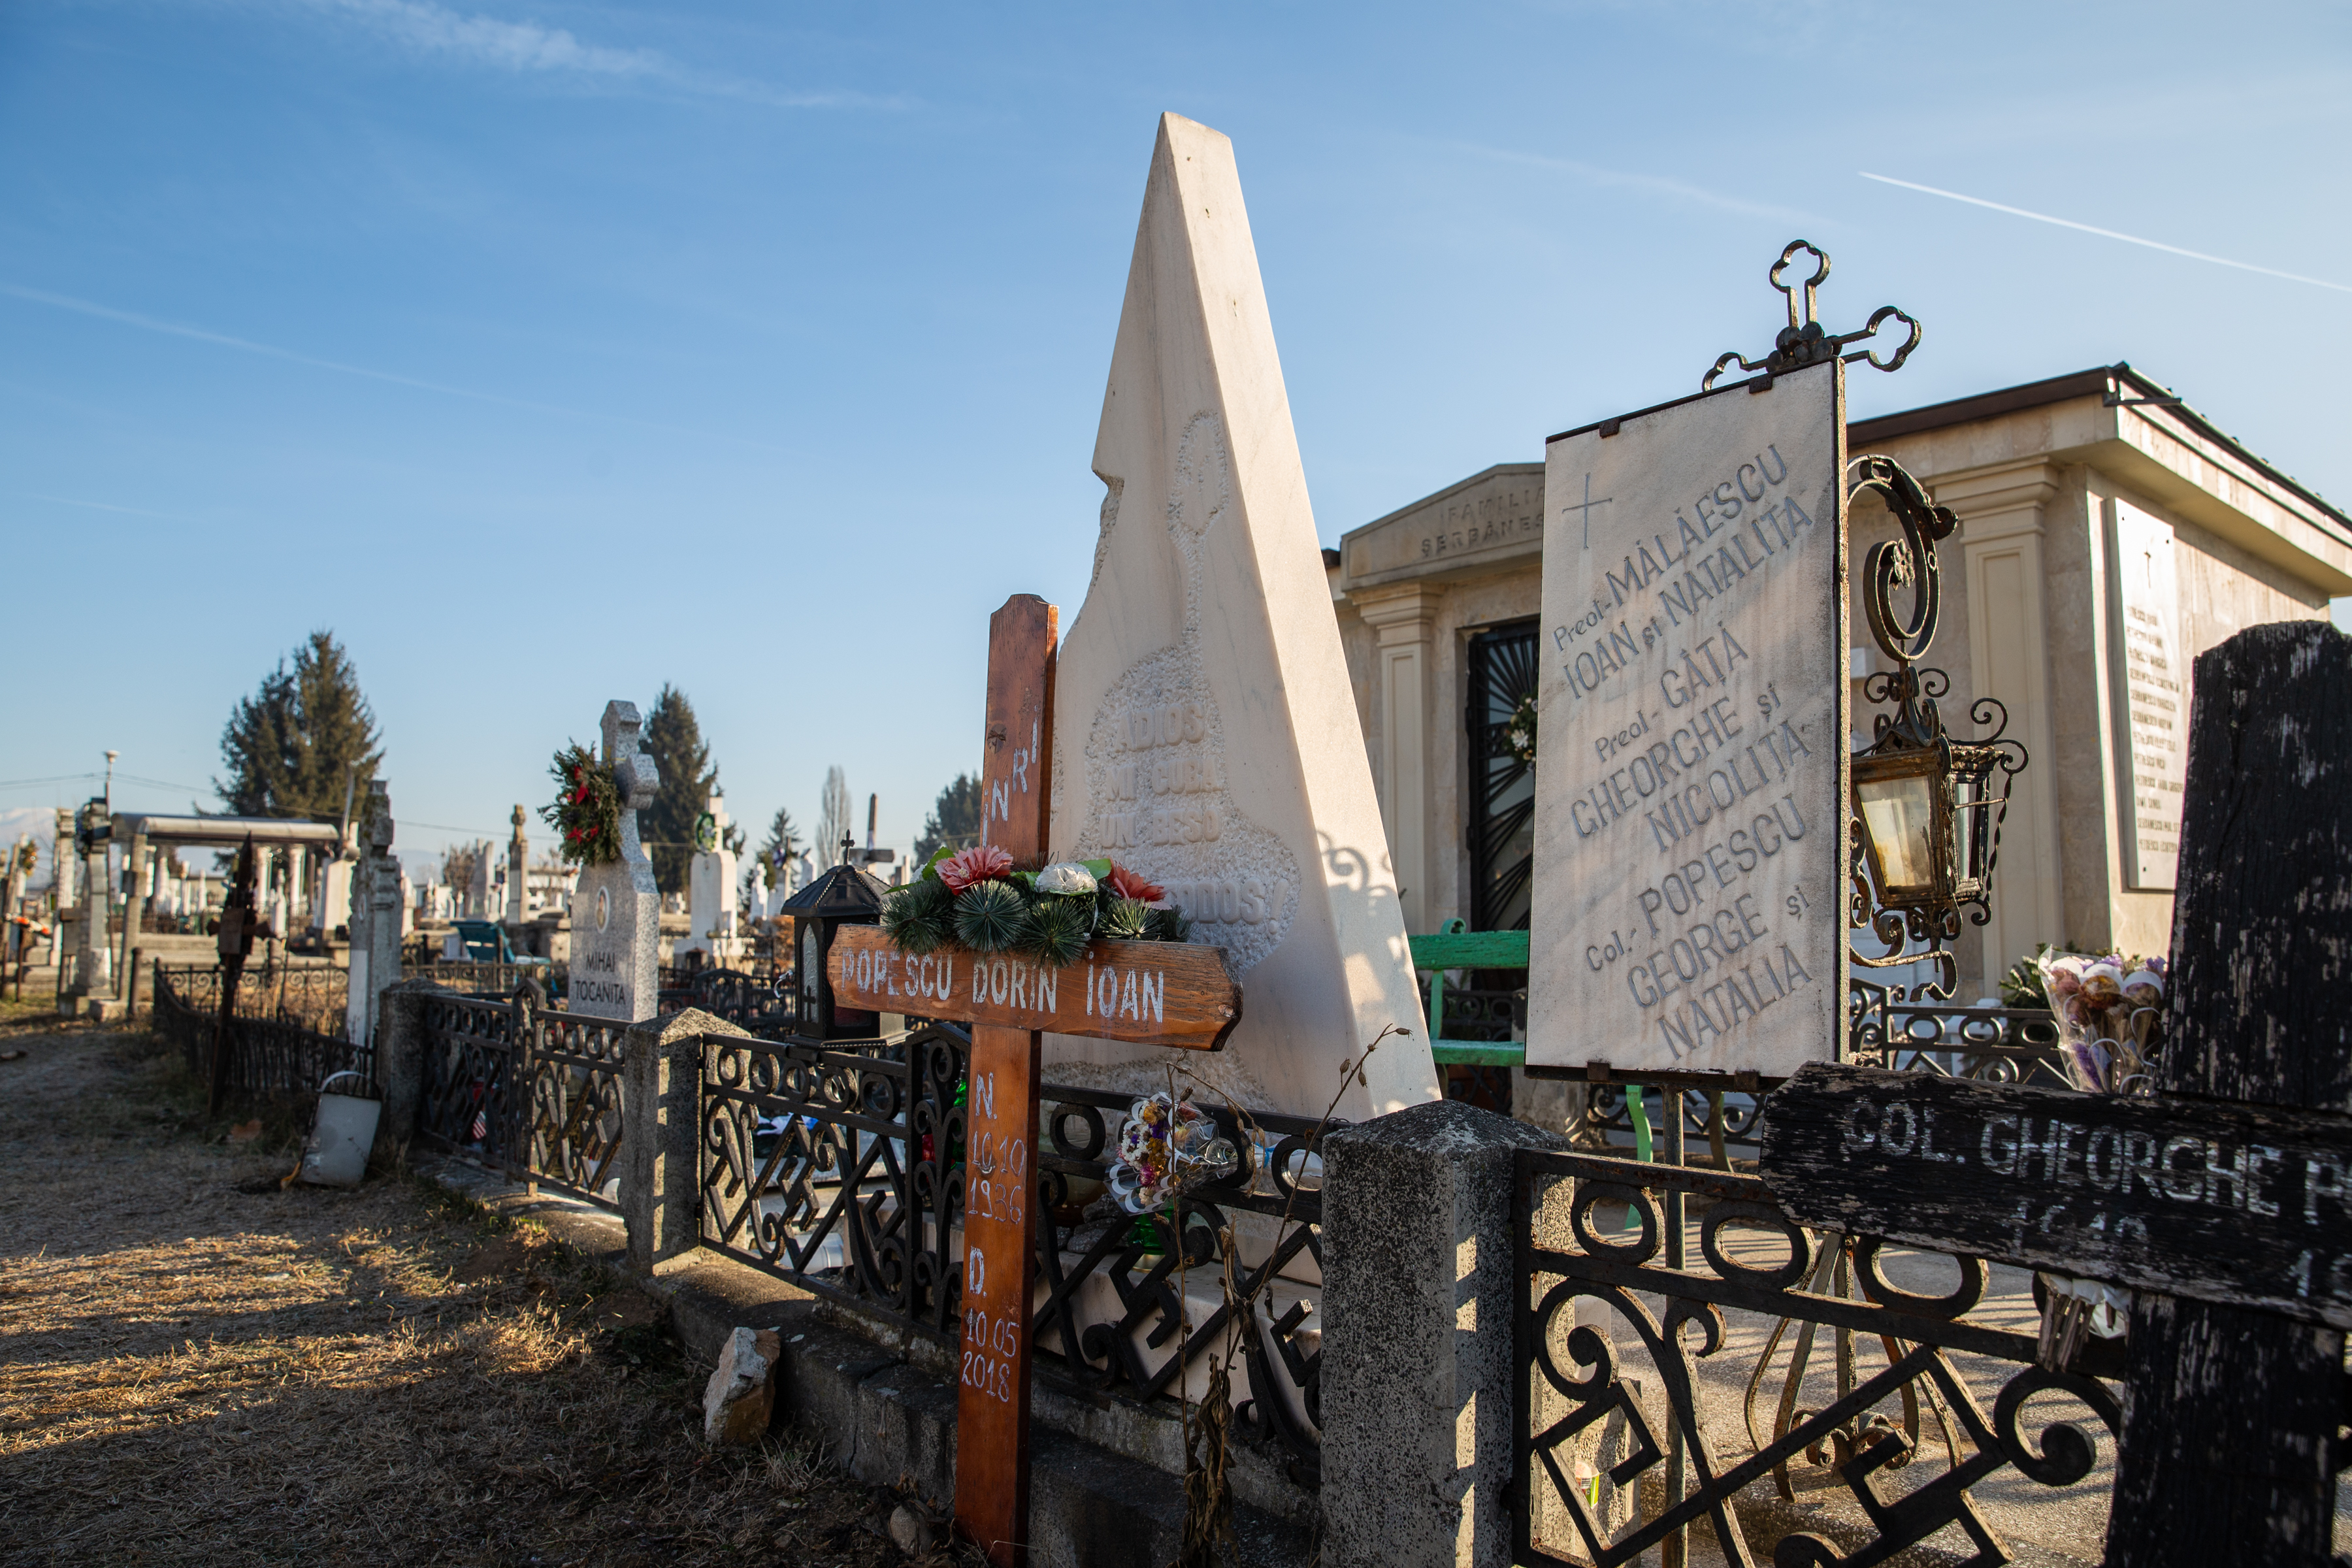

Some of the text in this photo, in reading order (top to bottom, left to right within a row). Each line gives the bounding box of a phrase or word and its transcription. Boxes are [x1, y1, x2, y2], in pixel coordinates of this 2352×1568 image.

[1563, 621, 1640, 700] IOAN
[1115, 701, 1205, 753] ADIOS
[1105, 755, 1223, 802] MI CUBA
[1571, 696, 1743, 838] GHEORGHE
[1100, 808, 1221, 849] UN BESO
[1638, 792, 1806, 939] POPESCU
[585, 951, 616, 973] MIHAI
[841, 947, 953, 1001] POPESCU
[972, 957, 1057, 1014] DORIN
[1627, 893, 1769, 1008] GEORGE
[1657, 942, 1813, 1061] NATALIA
[1980, 1111, 2281, 1217] GHEORGHE
[968, 1177, 1022, 1225] 1936
[966, 1307, 1020, 1358] 10.05
[961, 1350, 1011, 1403] 2018
